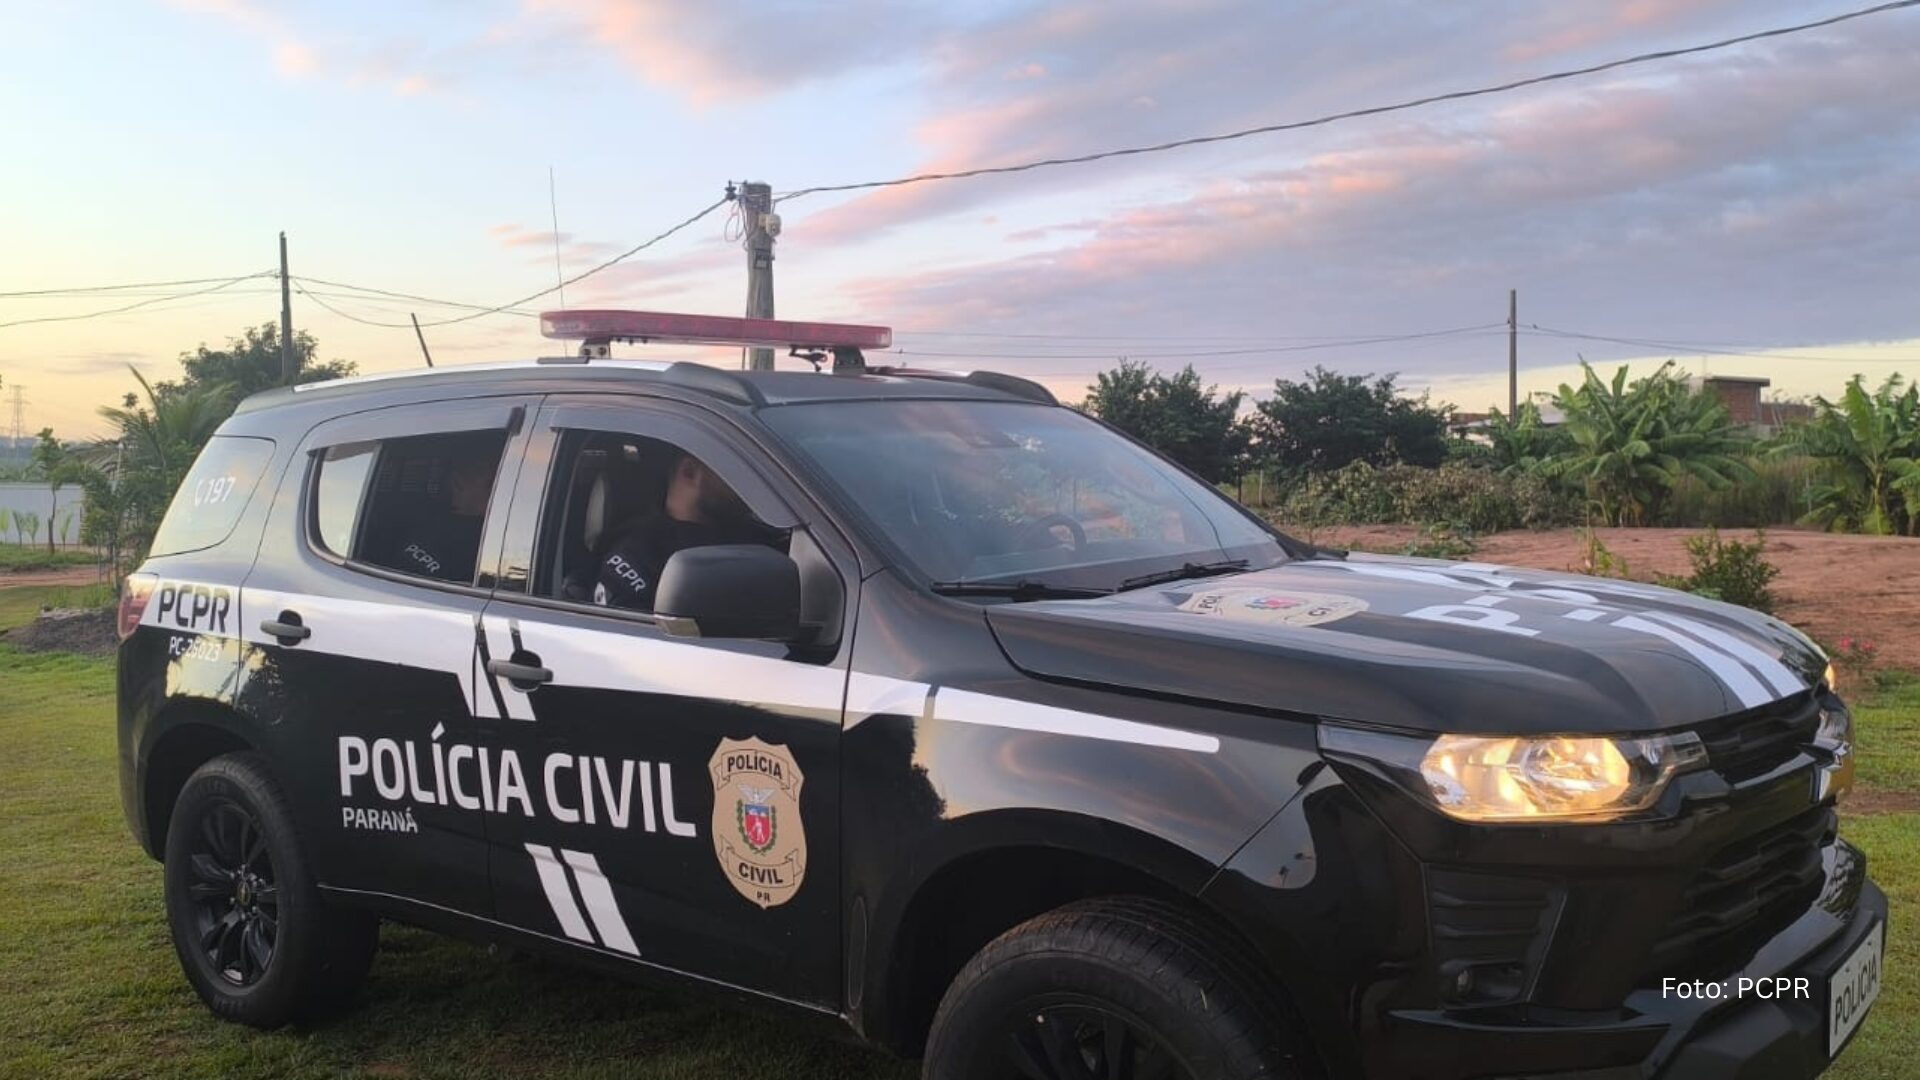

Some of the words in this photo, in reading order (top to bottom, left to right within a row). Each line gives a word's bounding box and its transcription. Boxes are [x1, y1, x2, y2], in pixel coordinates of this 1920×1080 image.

[203, 476, 237, 504] 197
[405, 544, 441, 573] PCPR
[607, 554, 647, 593] PCPR
[157, 583, 231, 633] PCPR
[338, 721, 536, 817] POLÍCIA
[543, 752, 697, 838] CIVIL
[342, 806, 419, 834] PARANÁ
[738, 862, 784, 884] CIVIL
[756, 890, 771, 902] PR
